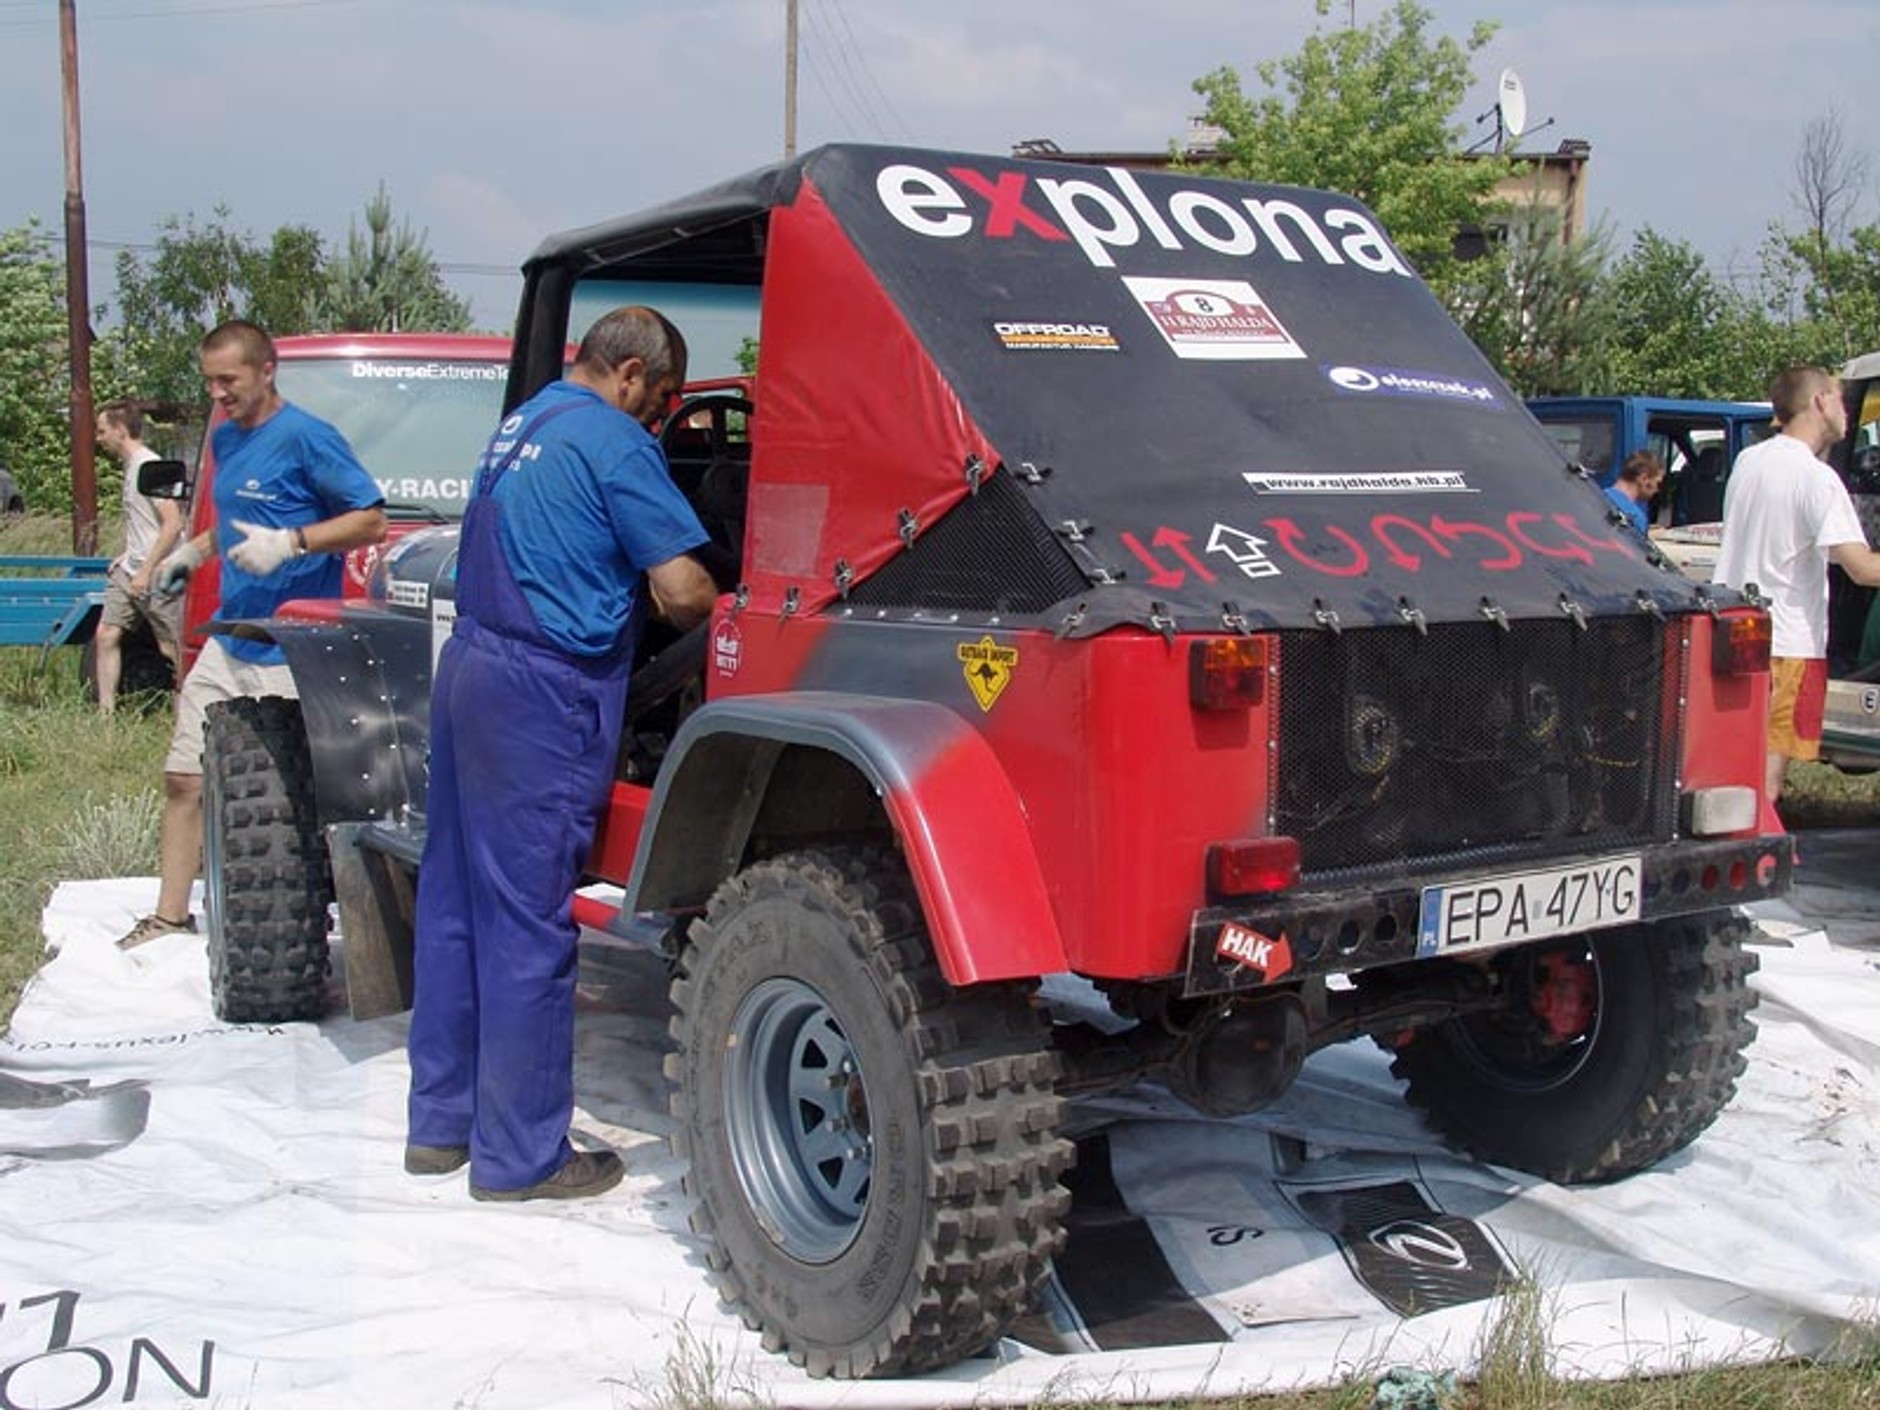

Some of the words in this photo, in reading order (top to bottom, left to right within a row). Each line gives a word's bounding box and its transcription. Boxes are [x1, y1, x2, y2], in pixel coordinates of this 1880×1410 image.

[876, 163, 1412, 276] explona
[1195, 296, 1214, 313] 8
[993, 321, 1111, 336] OFFROAD
[1447, 883, 1529, 945] EPA
[1546, 864, 1636, 927] 47YG
[1222, 927, 1273, 968] HAK
